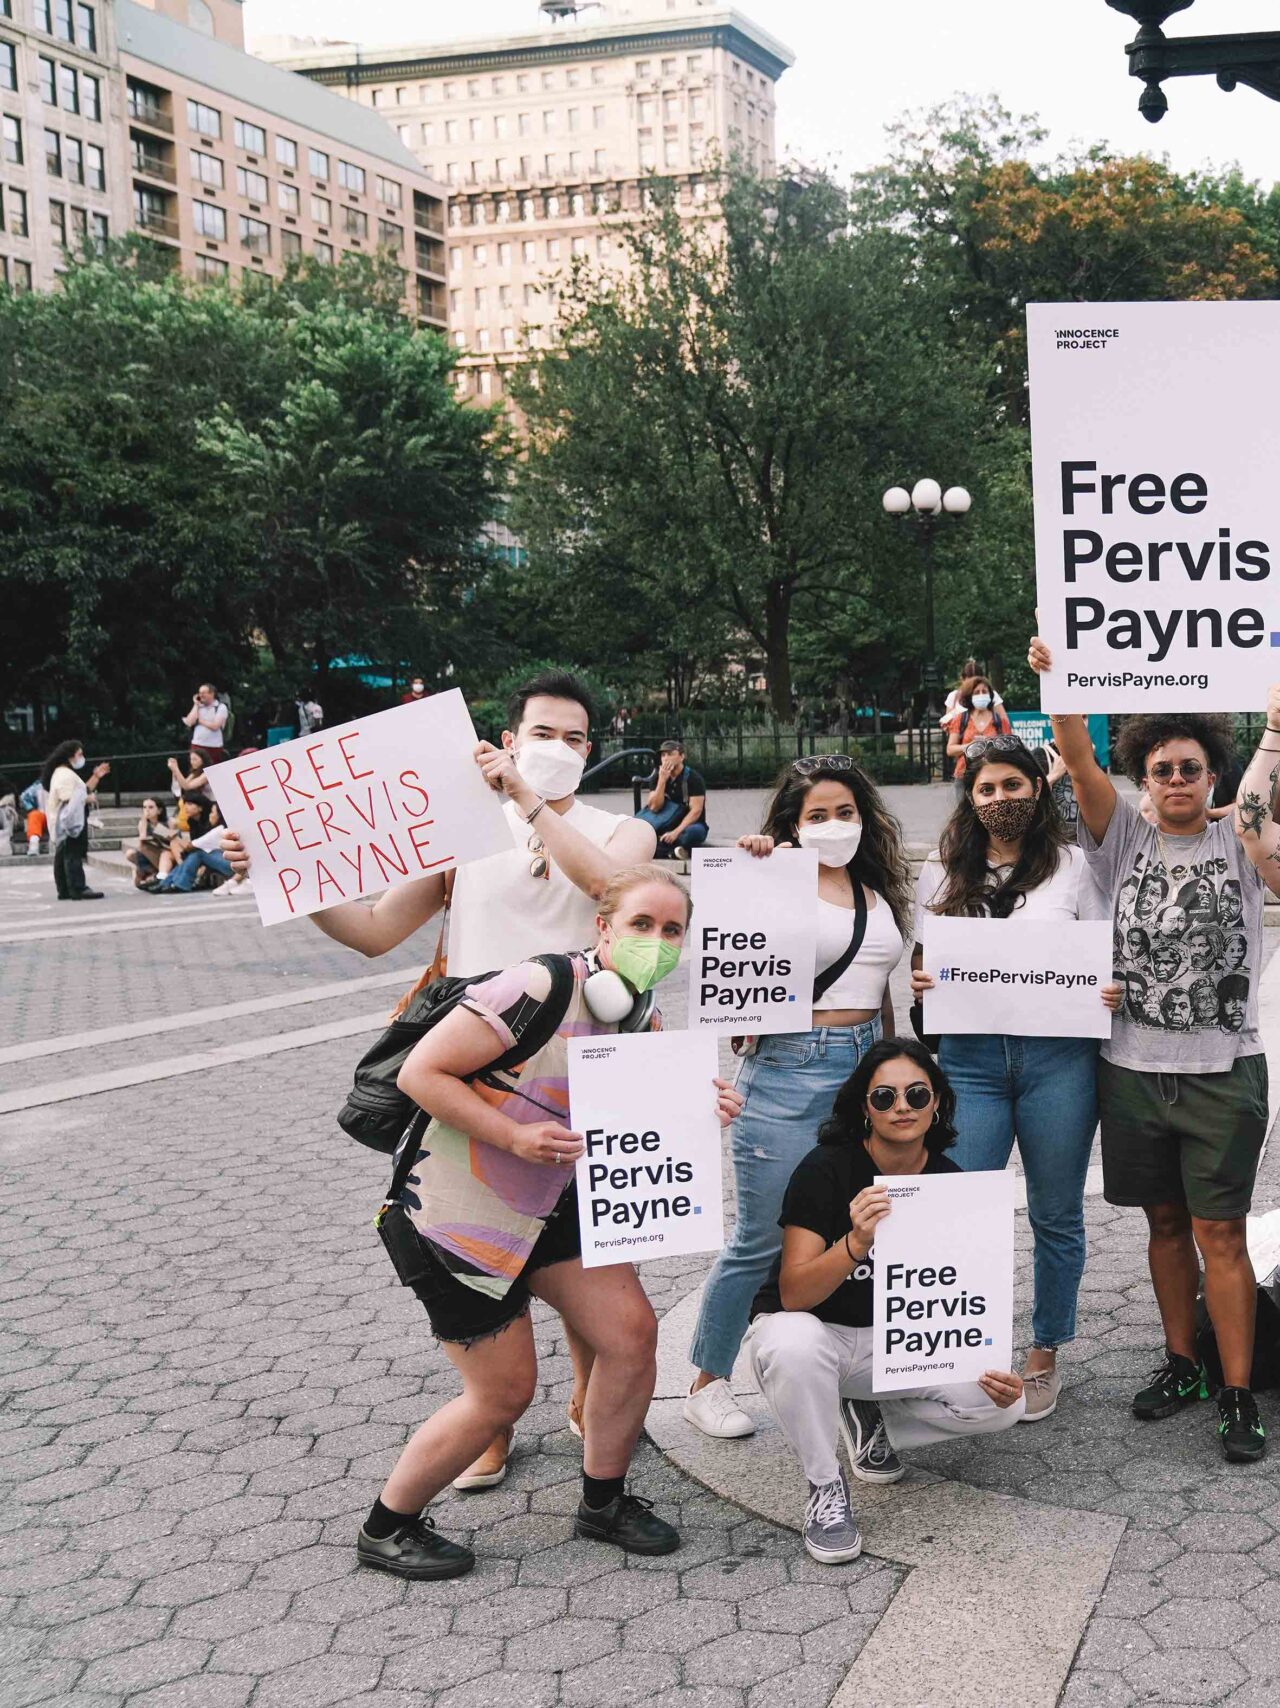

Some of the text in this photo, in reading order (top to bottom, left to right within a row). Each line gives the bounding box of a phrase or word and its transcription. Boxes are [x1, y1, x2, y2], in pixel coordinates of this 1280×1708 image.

[1054, 328, 1120, 339] INNOCENCE
[1056, 339, 1108, 350] PROJECT
[1060, 460, 1208, 515] Free
[1063, 527, 1271, 583] Pervis
[1067, 672, 1209, 690] PervisPayne.org
[235, 731, 375, 811] FREE
[257, 769, 430, 862] PERVIS
[278, 820, 455, 913] PAYNE
[702, 927, 767, 951] Free
[701, 954, 792, 979] Pervis
[939, 967, 1098, 989] #FreePervisPayne
[700, 984, 796, 1010] Payne.
[700, 1015, 762, 1024] PervisPayne.org
[585, 1128, 660, 1158] Free
[589, 1156, 694, 1192] Pervis
[592, 1194, 702, 1229] Payne.
[594, 1232, 664, 1249] PervisPayne.org
[885, 1263, 958, 1291] Free
[885, 1290, 986, 1323] Pervis
[885, 1326, 993, 1357] Payne.
[884, 1361, 956, 1375] PervisPayne.org
